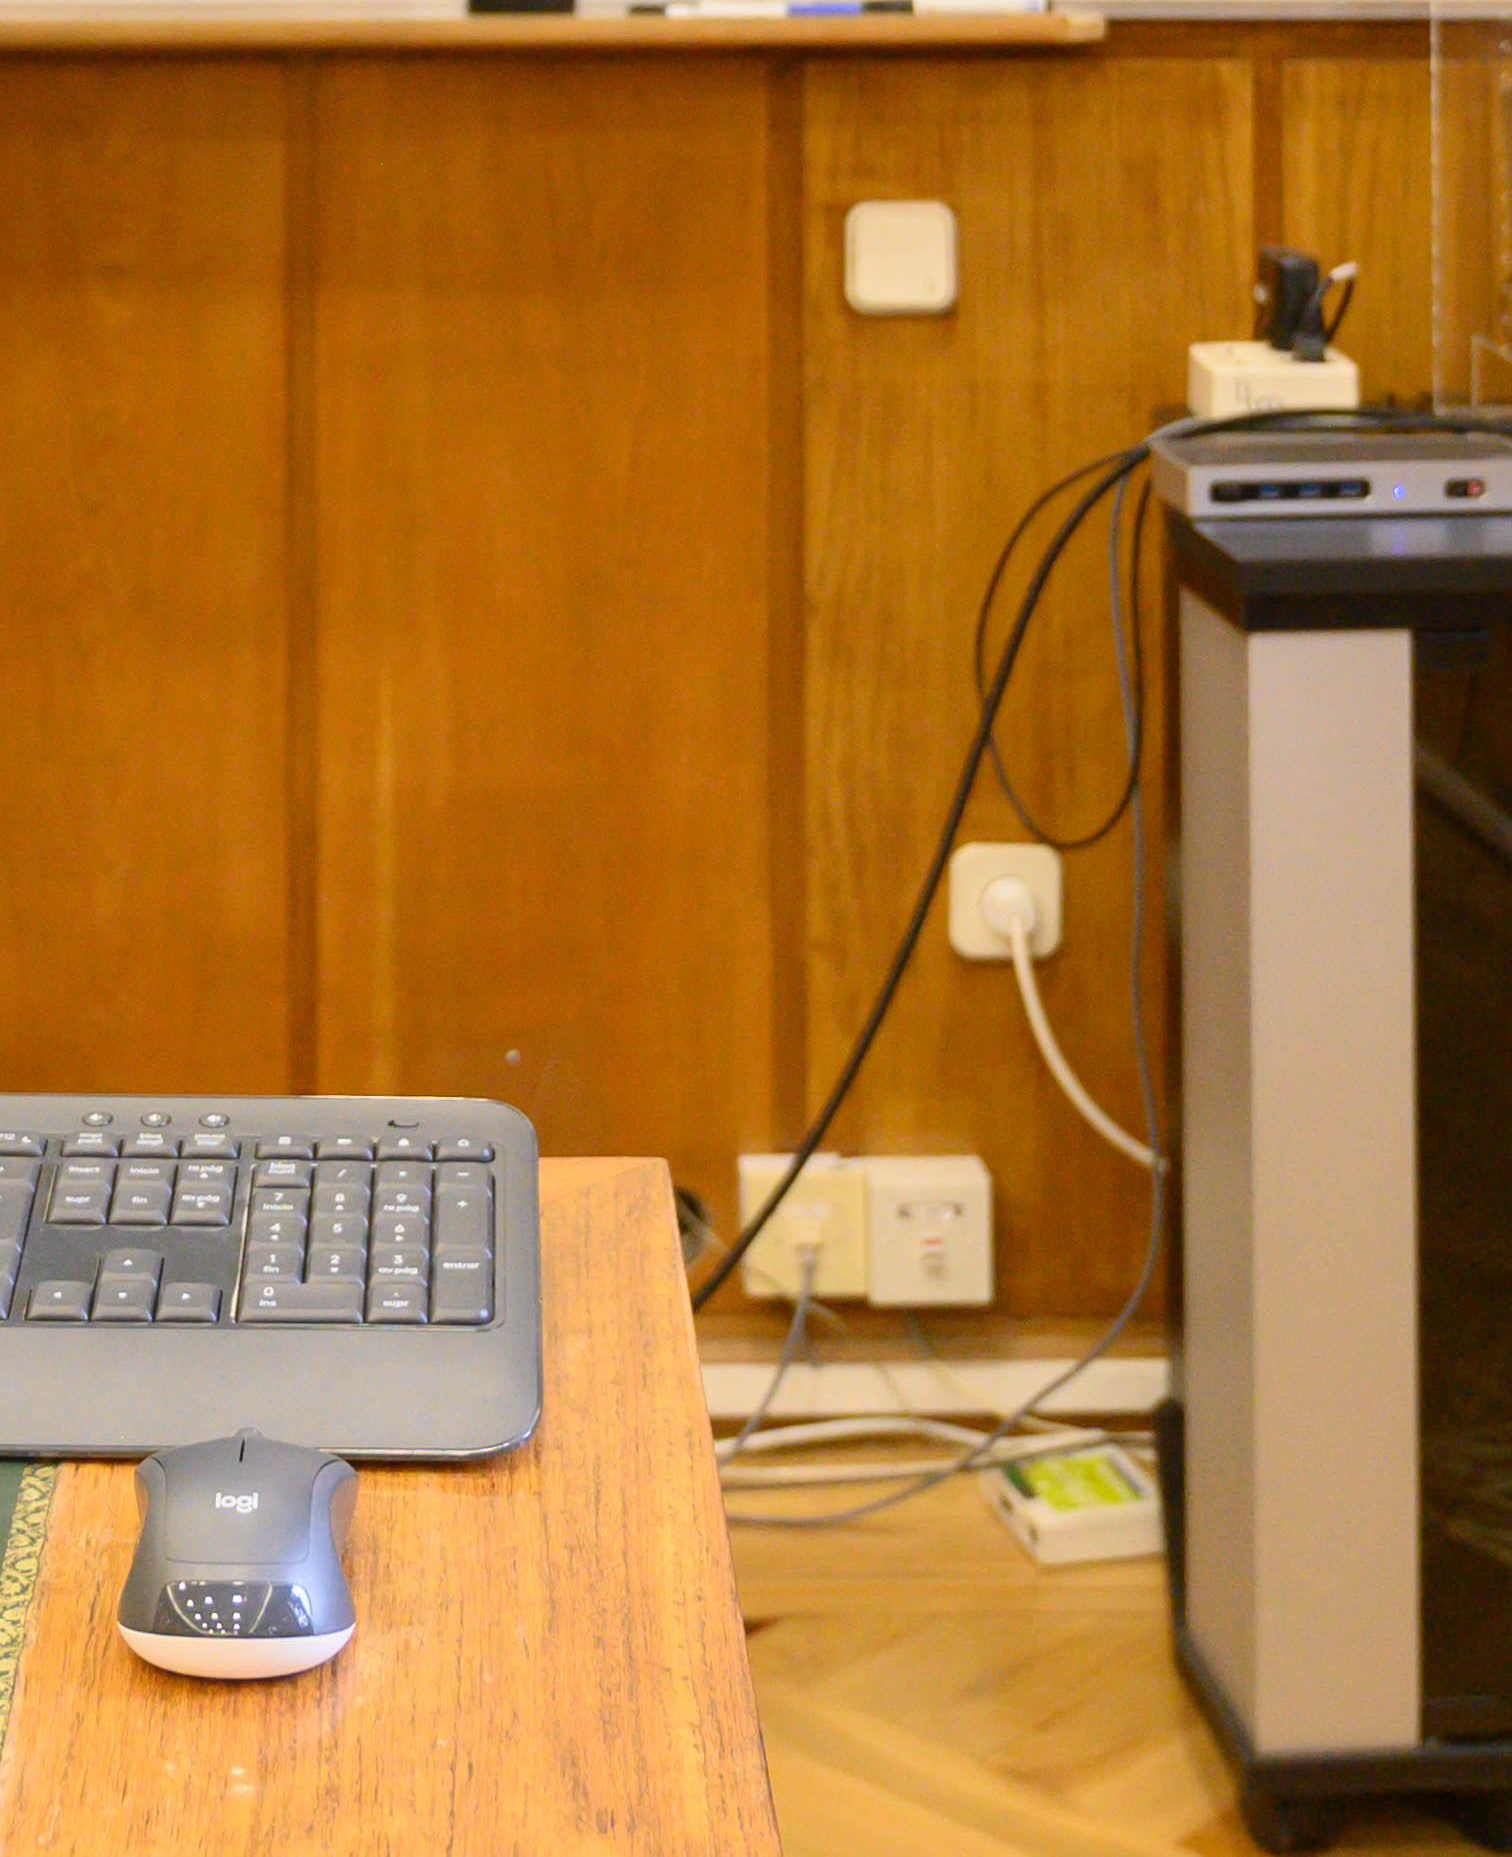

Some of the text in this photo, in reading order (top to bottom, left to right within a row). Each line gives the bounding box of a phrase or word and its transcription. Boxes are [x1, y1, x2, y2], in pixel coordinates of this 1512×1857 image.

[274, 1193, 284, 1202] 7
[334, 1193, 346, 1203] 8
[396, 1193, 407, 1203] 9
[269, 1223, 282, 1232] 4
[332, 1223, 343, 1233] 5
[394, 1223, 406, 1233] 6
[270, 1254, 277, 1264] 1
[330, 1255, 340, 1264] 2
[393, 1255, 403, 1265] 3
[442, 1261, 481, 1270] entrar
[263, 1287, 274, 1296] 0
[215, 1492, 258, 1513] logi
